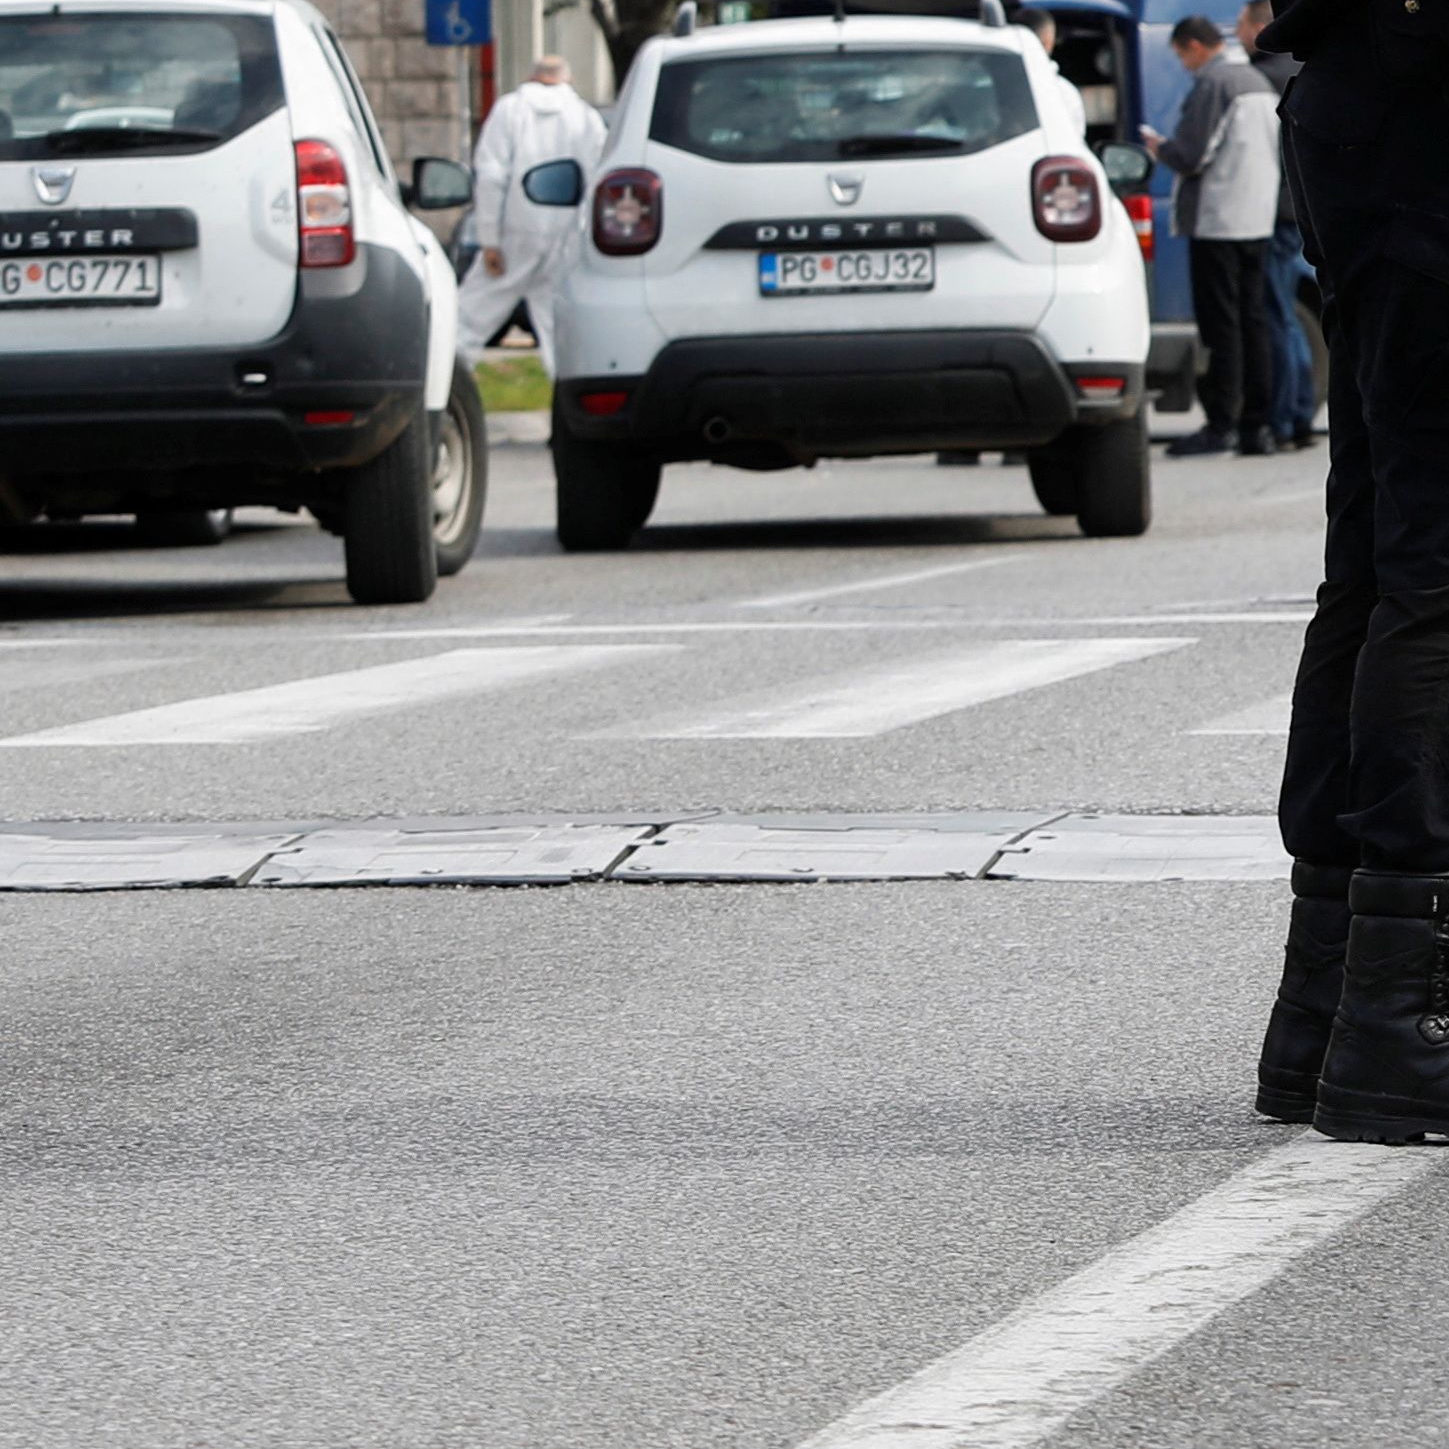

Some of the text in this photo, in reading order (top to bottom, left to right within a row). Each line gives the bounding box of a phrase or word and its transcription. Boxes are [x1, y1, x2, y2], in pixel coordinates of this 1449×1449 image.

[0, 229, 133, 249] USTER
[756, 222, 937, 242] DUSTER
[0, 259, 153, 295] G CG771
[782, 253, 928, 282] PG CGJ32
